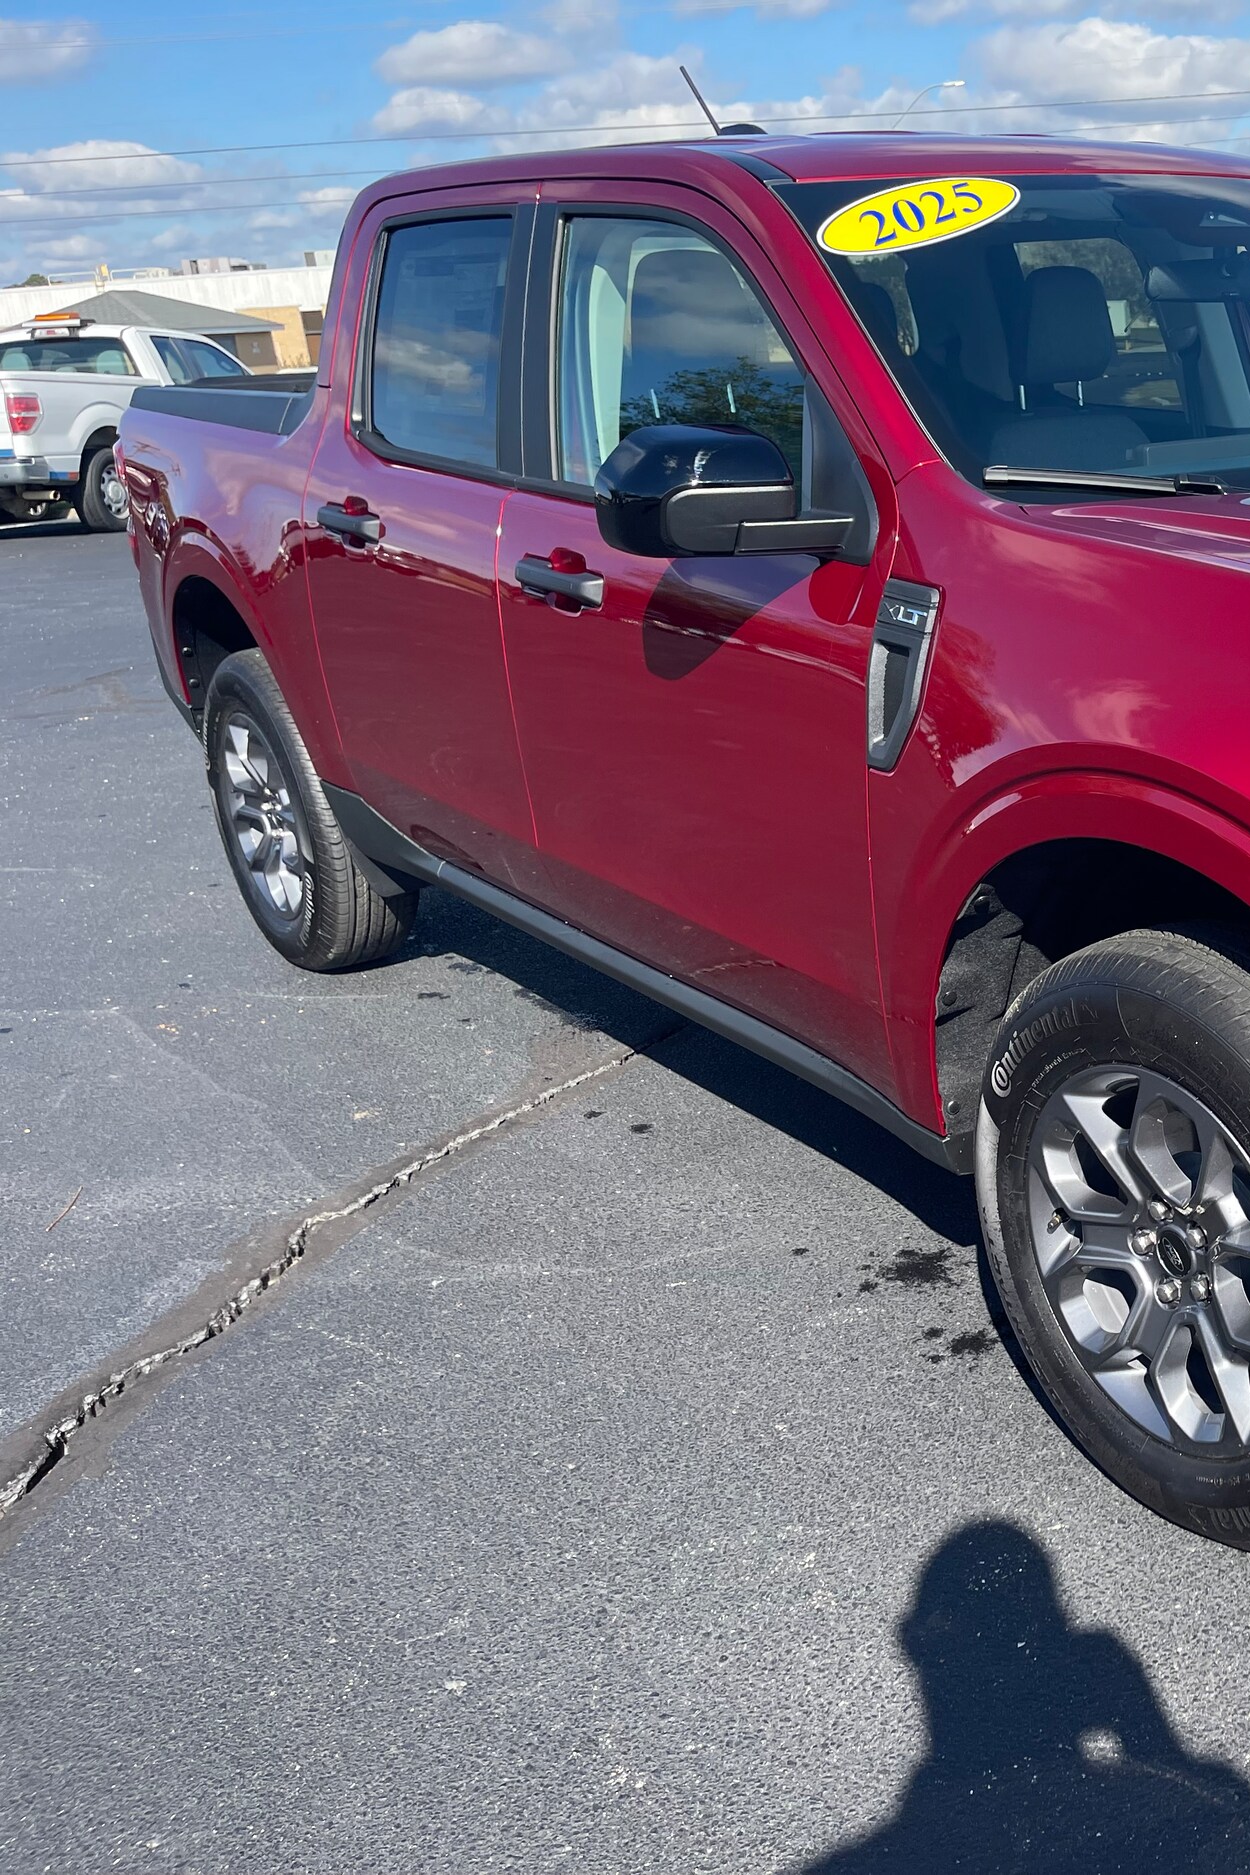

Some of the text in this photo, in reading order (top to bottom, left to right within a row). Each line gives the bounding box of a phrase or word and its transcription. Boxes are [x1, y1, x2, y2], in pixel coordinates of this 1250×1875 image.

[859, 182, 983, 247] 2025
[879, 601, 928, 626] XLT
[991, 997, 1080, 1098] Continental
